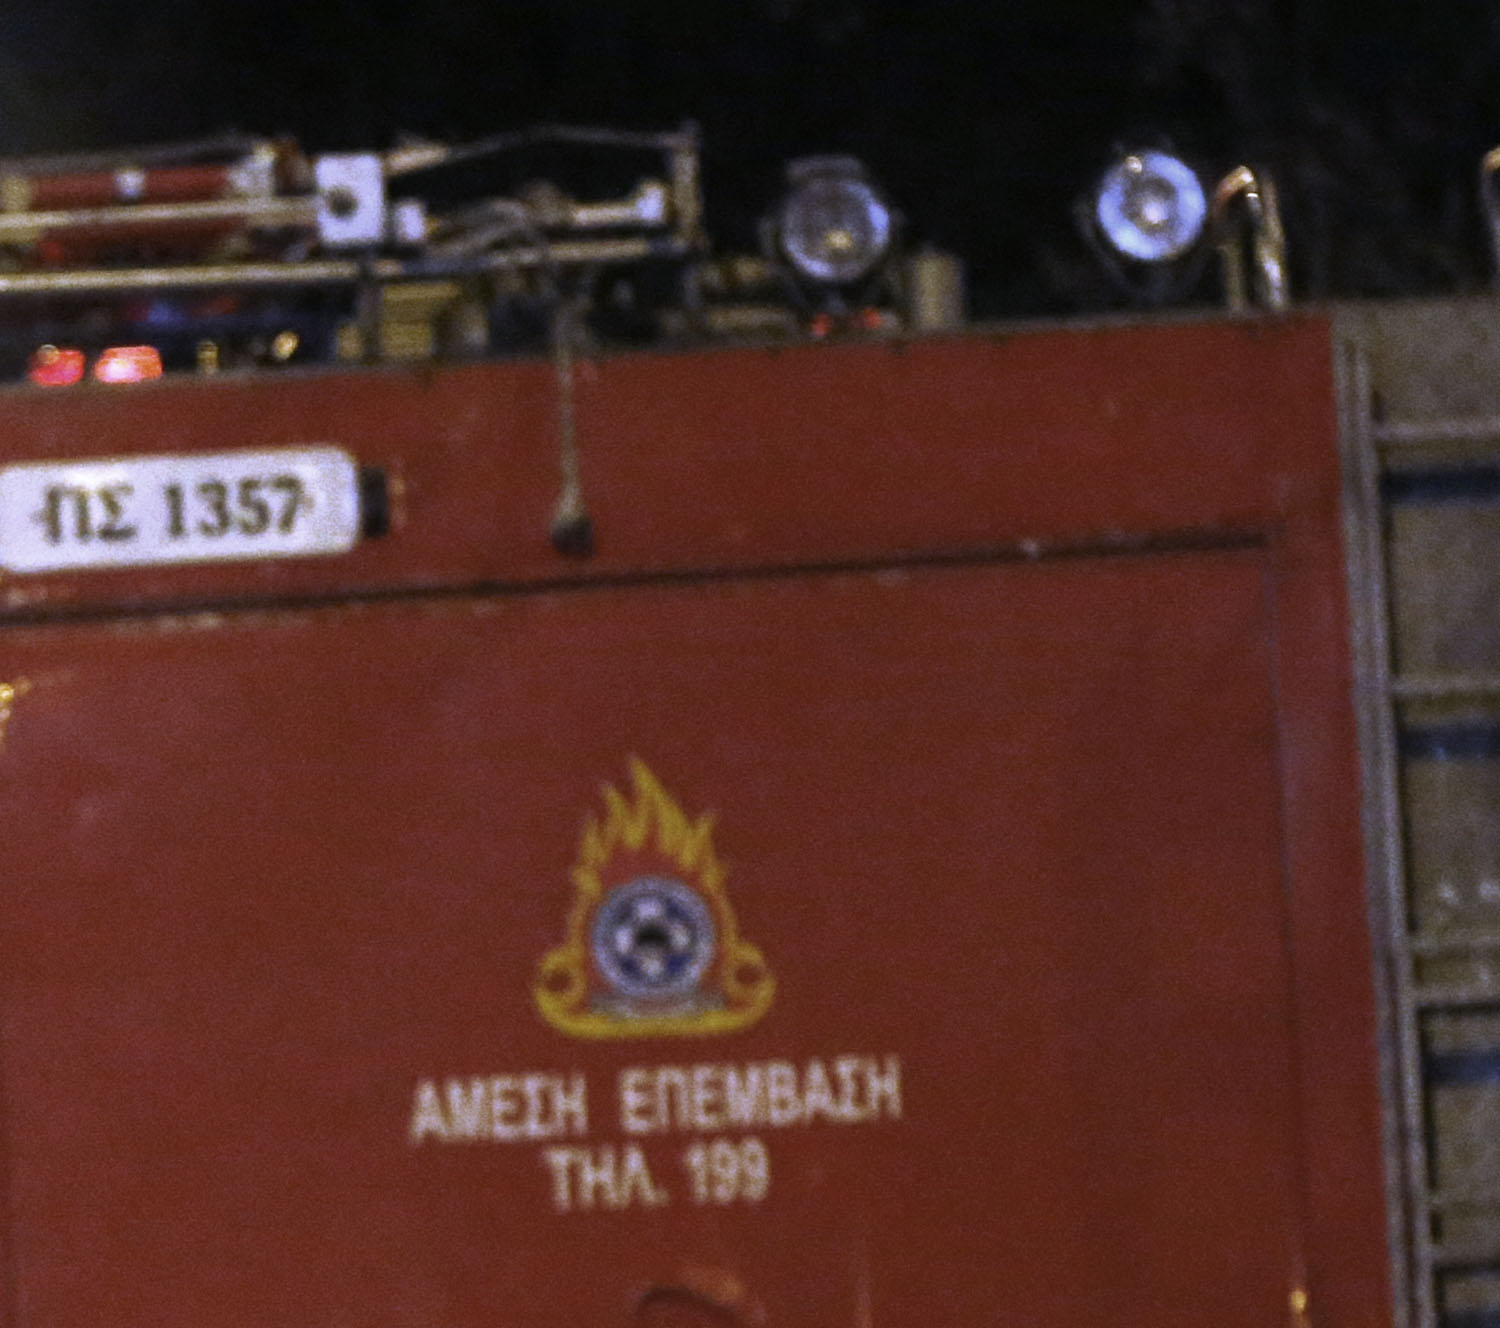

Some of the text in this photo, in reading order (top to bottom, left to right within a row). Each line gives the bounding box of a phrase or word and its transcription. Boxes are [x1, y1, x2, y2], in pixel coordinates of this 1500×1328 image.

[44, 473, 305, 546] ΠΣ 1357
[411, 1055, 903, 1145] ΑΜΕΣΗ ΕΠΕΜΒΑΣΗ
[682, 1135, 771, 1205] 199
